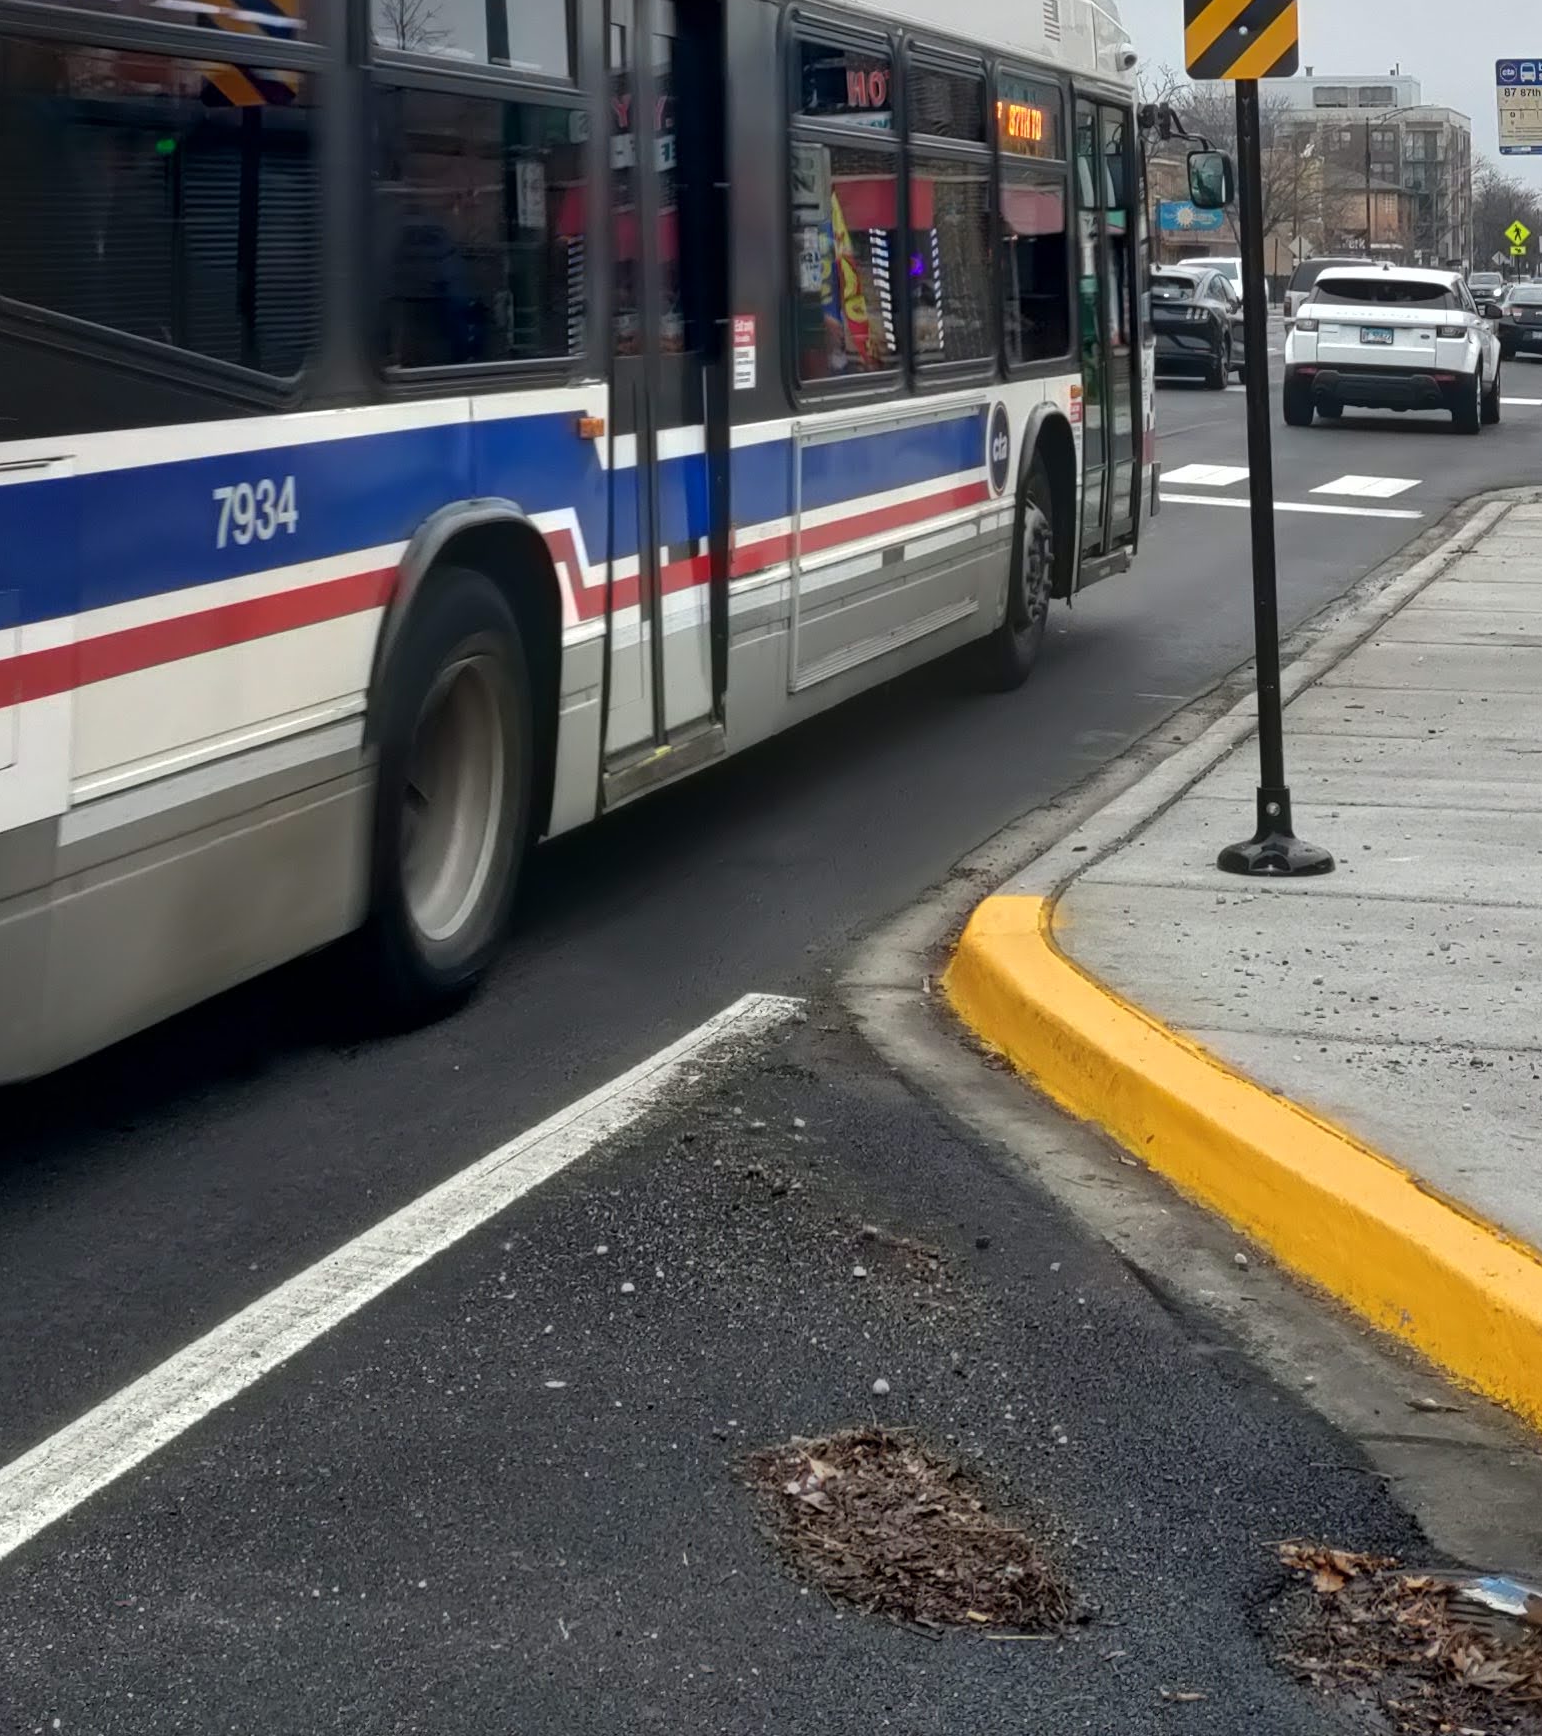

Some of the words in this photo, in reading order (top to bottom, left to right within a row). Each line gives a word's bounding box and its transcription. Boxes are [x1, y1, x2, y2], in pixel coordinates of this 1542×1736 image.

[1504, 88, 1516, 97] 87
[1520, 88, 1541, 96] 87th
[993, 431, 1008, 462] cta
[212, 475, 298, 550] 7934
